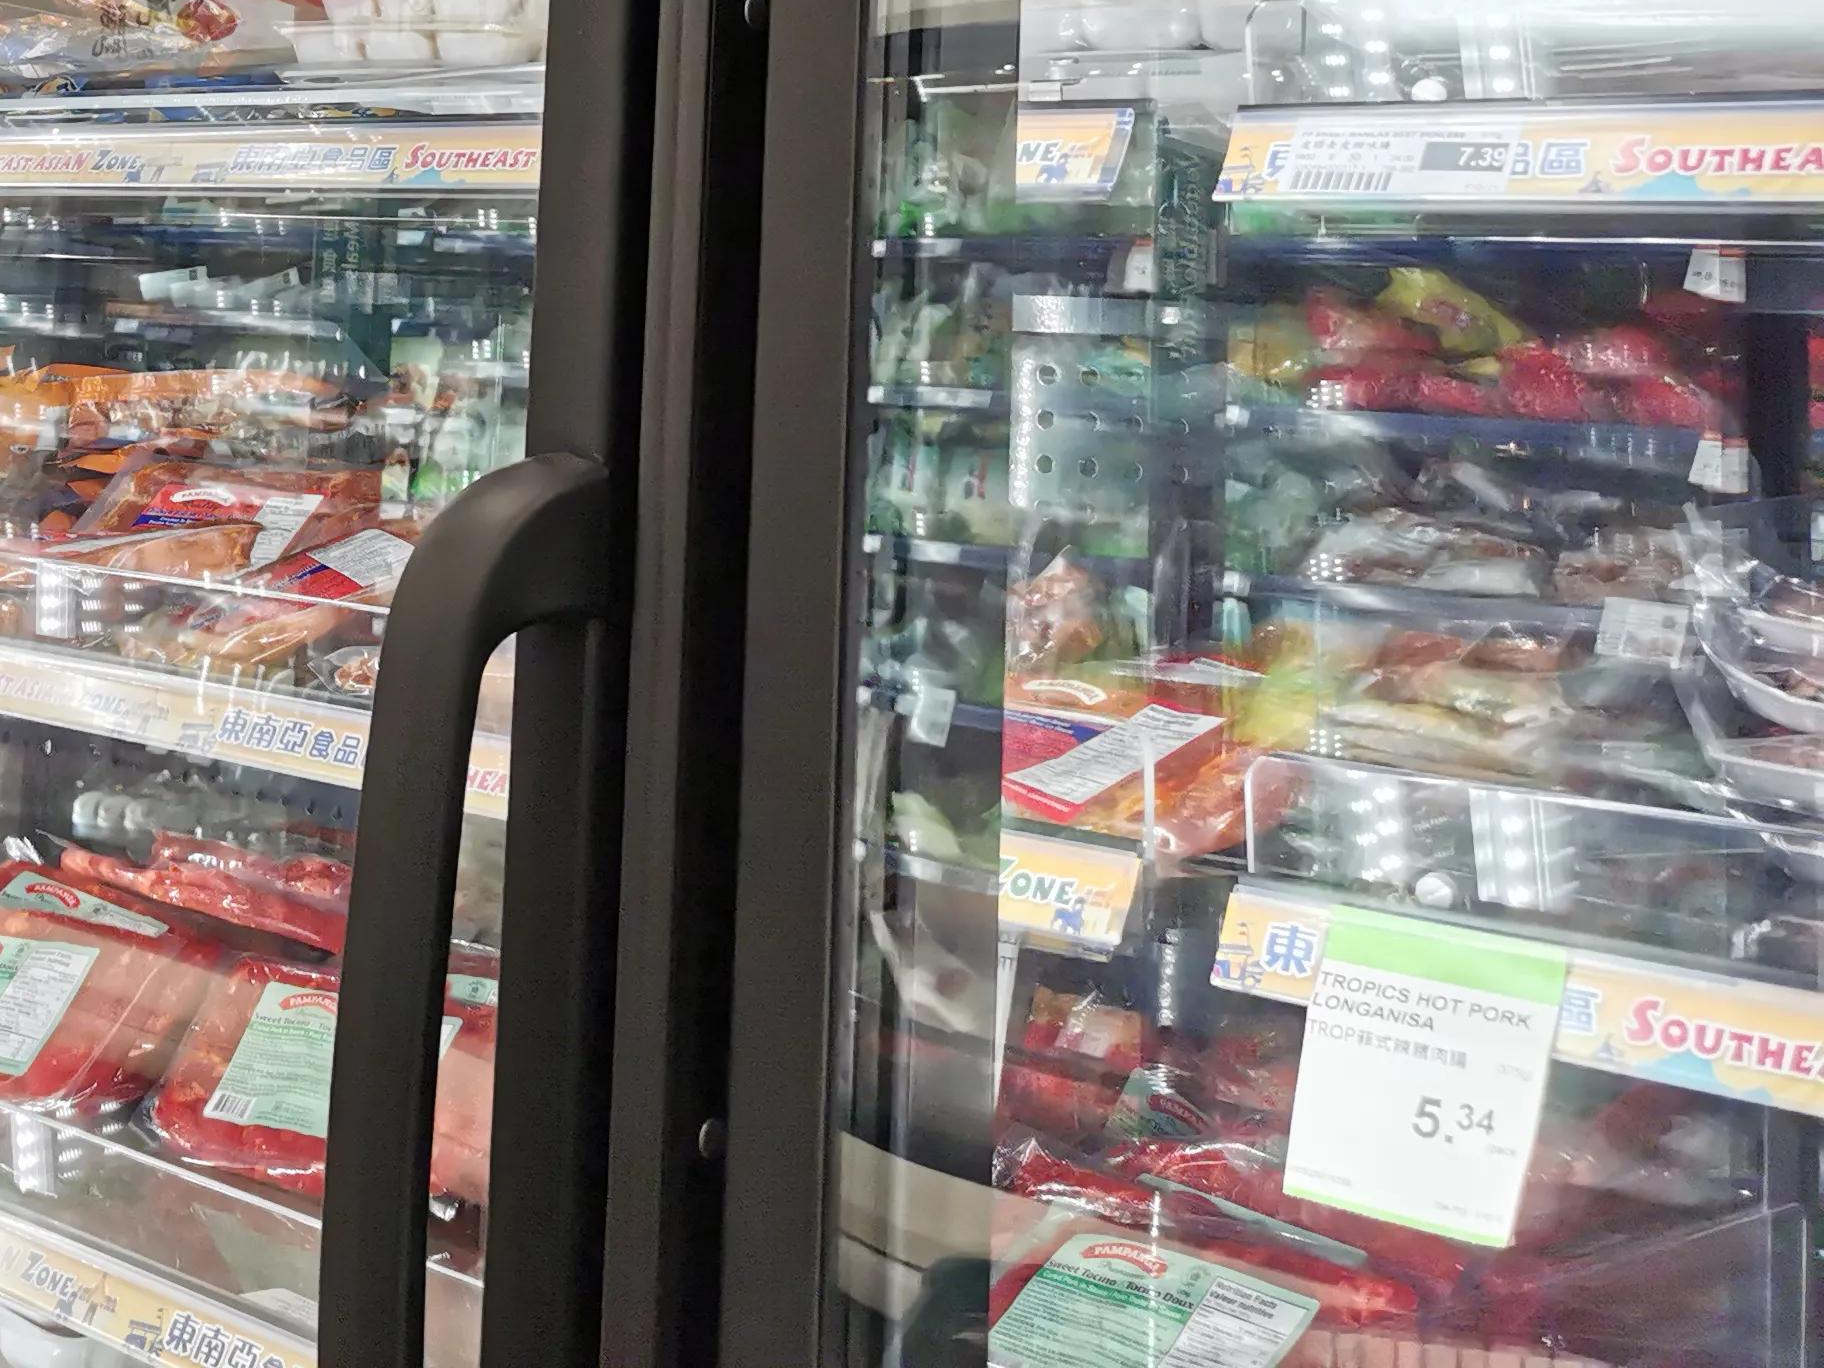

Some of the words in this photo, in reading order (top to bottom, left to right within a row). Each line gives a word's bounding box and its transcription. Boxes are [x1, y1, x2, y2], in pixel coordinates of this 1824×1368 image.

[35, 149, 91, 173] ASIAN
[91, 148, 141, 173] ZONE
[403, 142, 539, 173] SOUTHEAST
[1457, 146, 1507, 168] 7.39
[217, 707, 364, 766] 東南亞食品
[999, 857, 1075, 906] ZONE
[1263, 923, 1319, 978] 東
[1312, 991, 1436, 1032] LONGANISA
[1320, 970, 1412, 1005] TROPICS
[1416, 993, 1465, 1017] HOT
[1468, 1002, 1535, 1032] PORK
[1625, 996, 1824, 1080] SOUTHE
[1411, 1094, 1496, 1145] 5.34
[21, 1250, 74, 1299] ZONE
